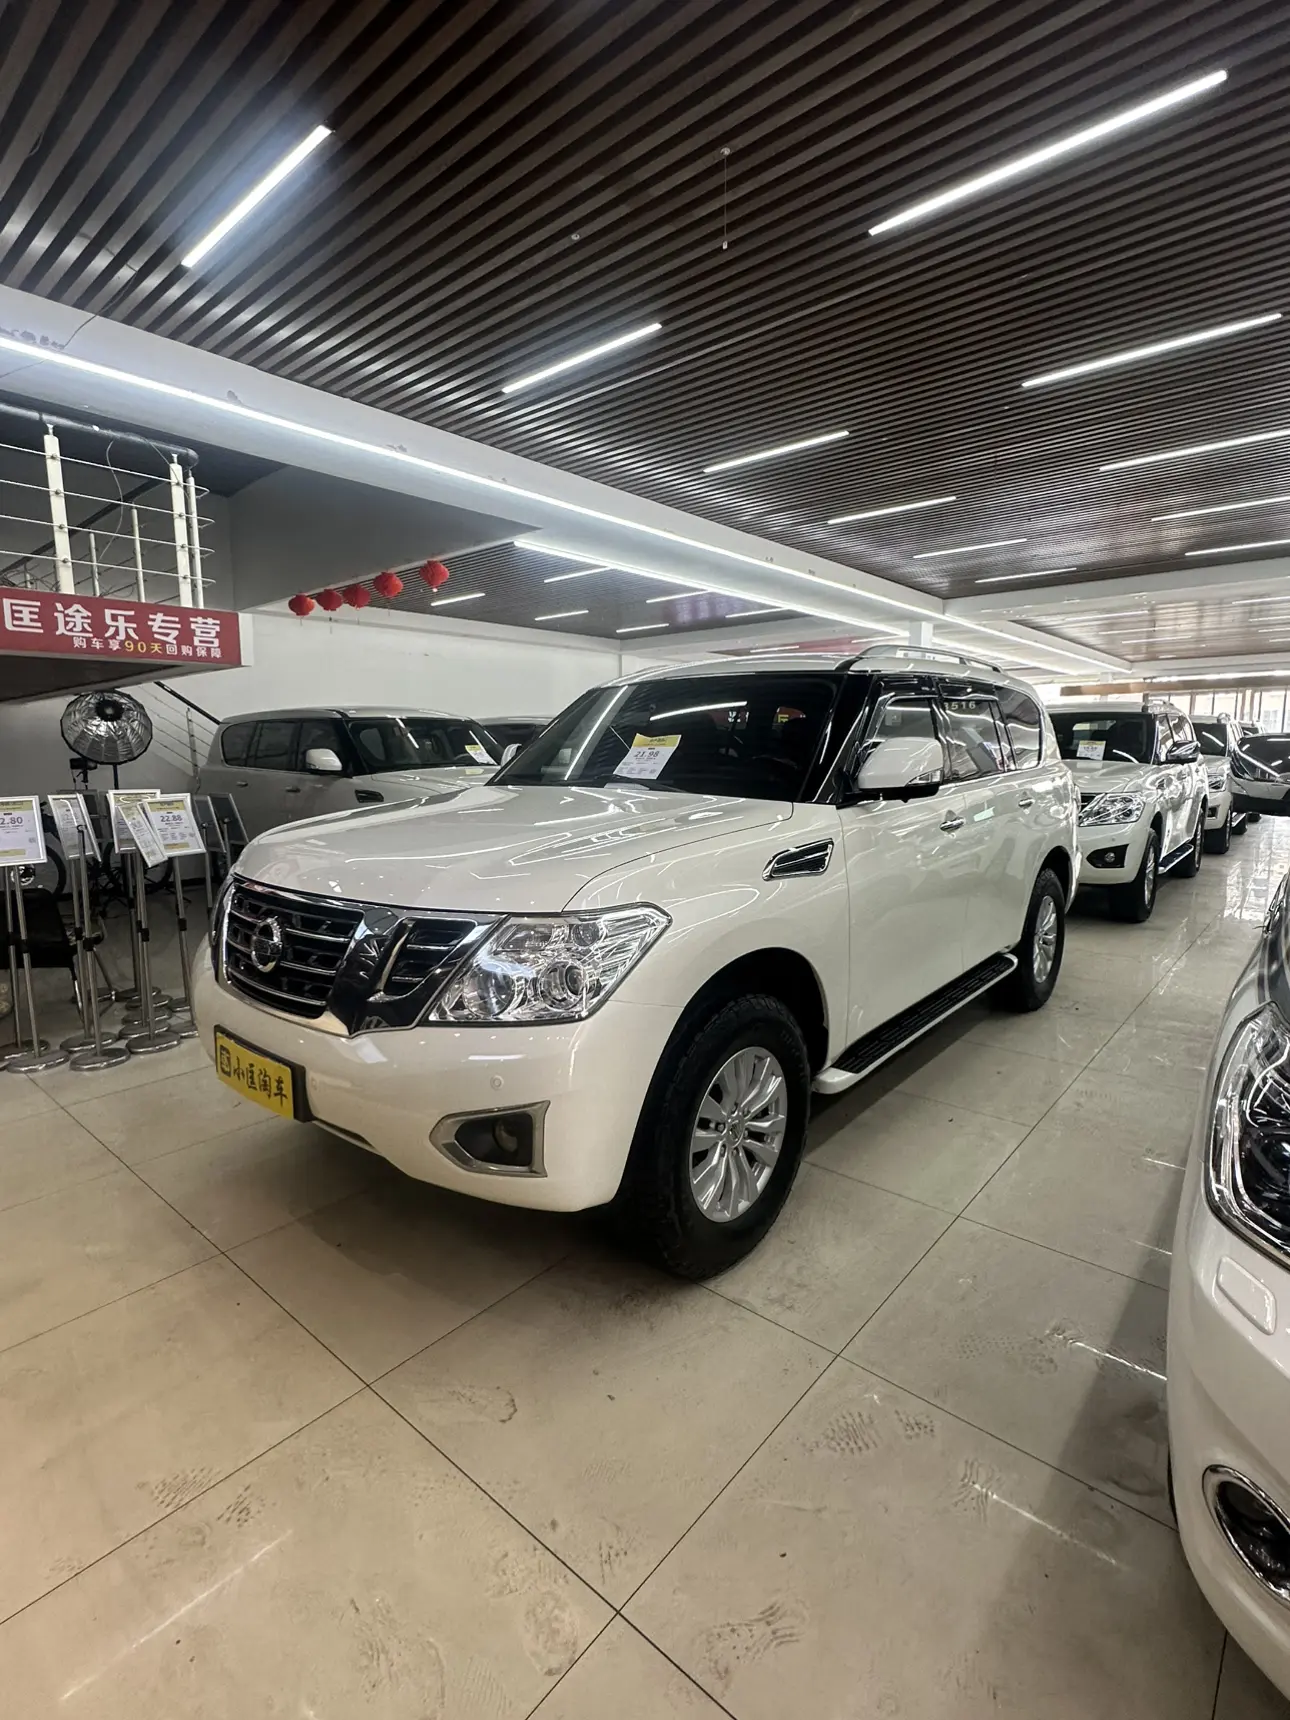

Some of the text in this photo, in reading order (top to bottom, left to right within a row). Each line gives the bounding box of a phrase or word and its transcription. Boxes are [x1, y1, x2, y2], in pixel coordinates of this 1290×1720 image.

[2, 597, 221, 648] 匡途乐专营
[72, 636, 222, 659] 购车享90天回购保障
[633, 750, 660, 758] 21.98
[233, 1055, 288, 1107] 小匡淘车
